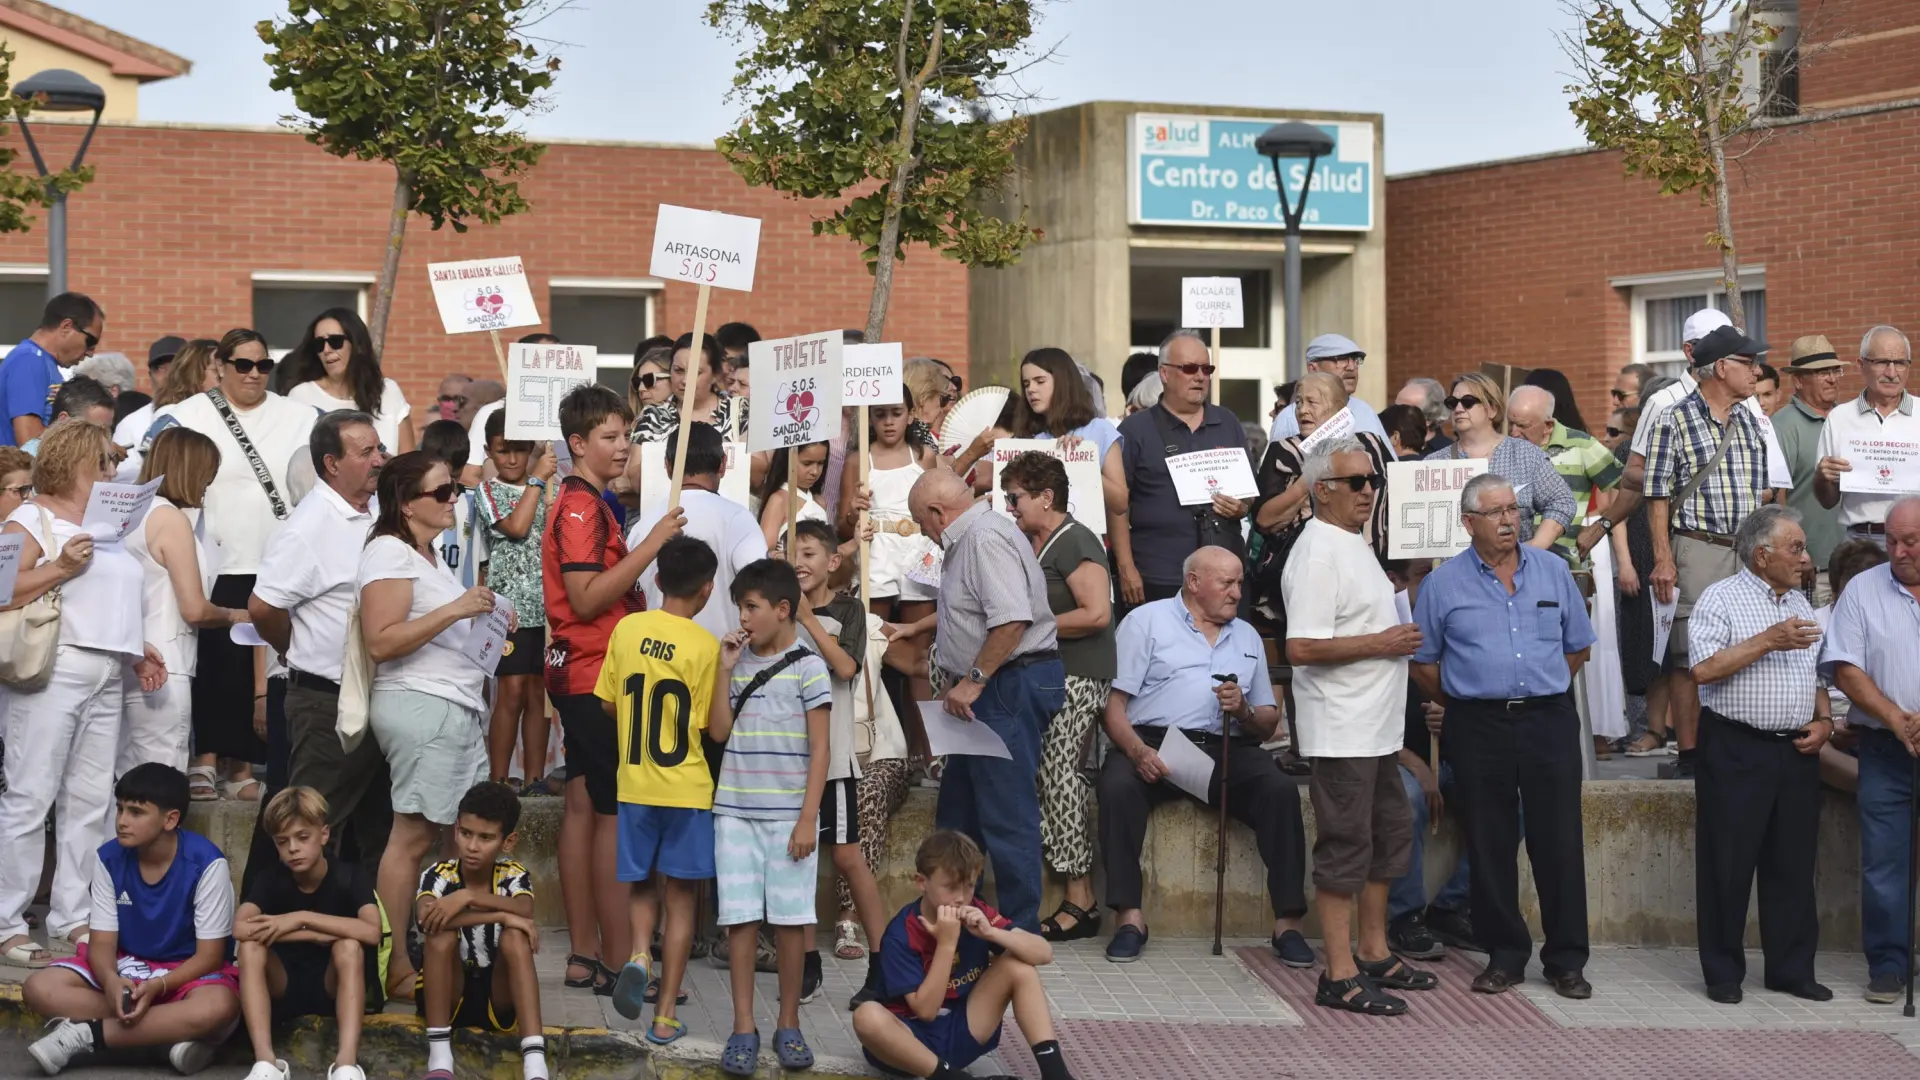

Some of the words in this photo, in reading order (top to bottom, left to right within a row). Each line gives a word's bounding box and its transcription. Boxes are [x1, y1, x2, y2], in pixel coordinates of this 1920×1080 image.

[1145, 119, 1199, 142] salud
[1147, 159, 1237, 189] Centro
[1248, 162, 1278, 190] de
[1289, 163, 1362, 193] Salud
[1192, 201, 1219, 219] Dr.
[1226, 202, 1268, 220] Paco
[664, 241, 741, 264] ARTASONA
[433, 270, 457, 281] SANTA
[458, 267, 485, 280] EULALIA
[485, 266, 492, 277] DE
[1225, 286, 1236, 296] DE
[1195, 300, 1231, 310] GURREA
[467, 313, 505, 325] SANIDAD
[480, 320, 507, 329] RURAL
[522, 348, 541, 369] LA
[545, 346, 583, 370] PEÑA
[773, 338, 829, 372] TRISTE
[226, 414, 246, 441] LOLA
[772, 421, 811, 438] SANIDAD
[1315, 430, 1326, 439] LOS
[241, 441, 252, 449] Y
[783, 432, 811, 446] RURAL
[1065, 450, 1095, 462] LOARRE
[1168, 457, 1180, 465] NO
[1204, 450, 1242, 458] RECORTES
[248, 449, 270, 485] BIMBA
[119, 491, 136, 500] LOS
[440, 544, 459, 568] 10
[640, 637, 676, 661] CRIS
[623, 673, 692, 768] 10
